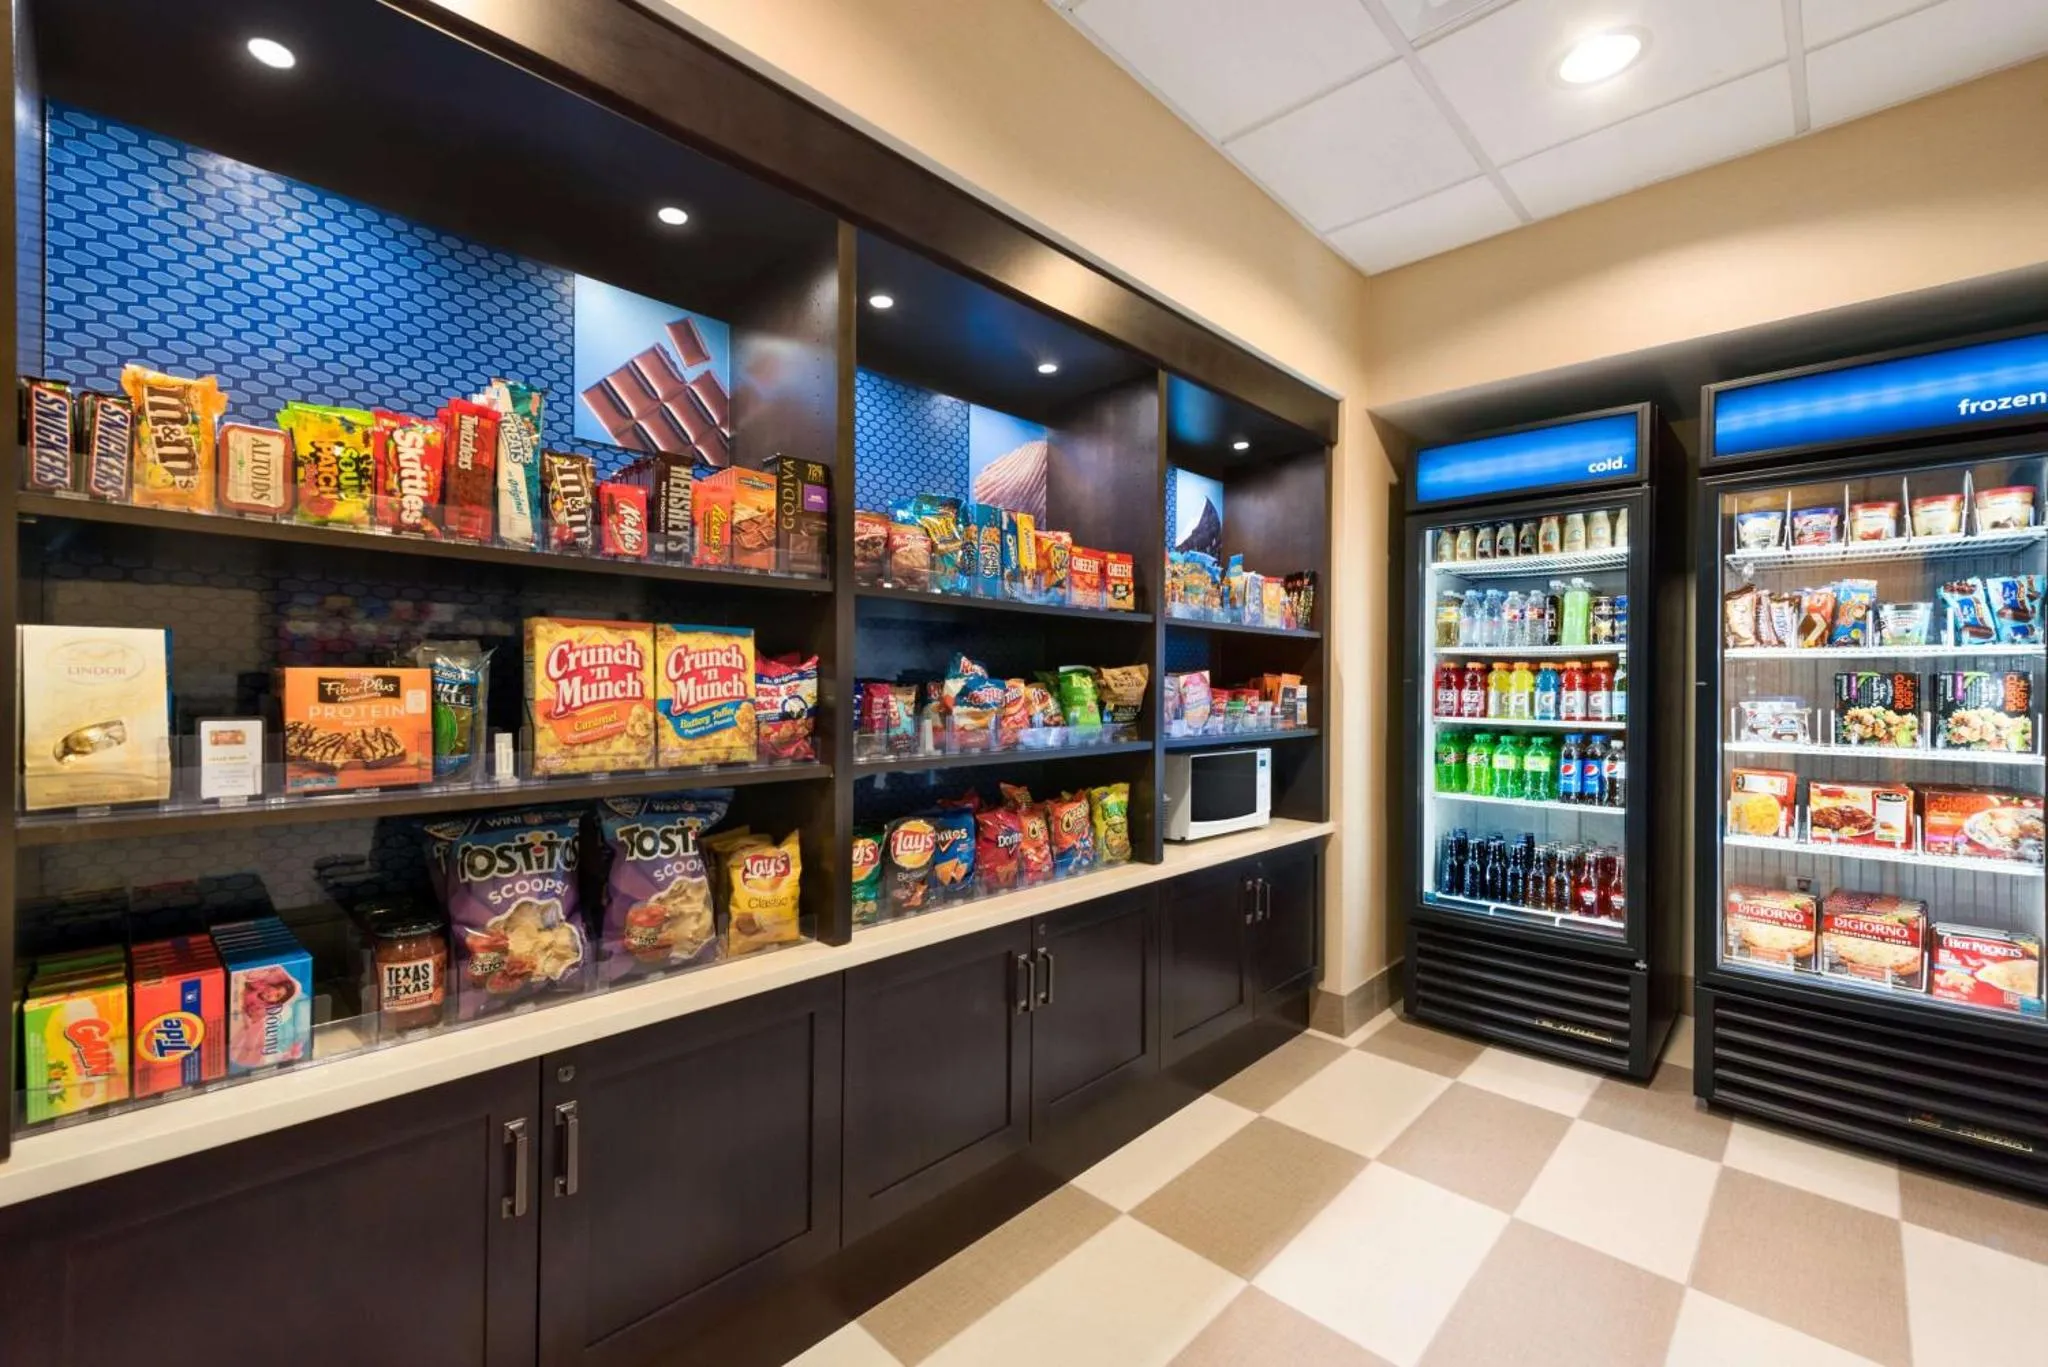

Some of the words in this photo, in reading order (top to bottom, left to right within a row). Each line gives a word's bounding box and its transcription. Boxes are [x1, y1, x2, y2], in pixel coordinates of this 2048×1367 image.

[34, 390, 70, 490] SNICKERS
[93, 403, 132, 499] SNICKERS
[458, 414, 479, 471] Twizzlers
[501, 412, 524, 464] TREATS
[250, 438, 272, 501] ALTOIDS
[314, 441, 340, 500] PATCH
[393, 429, 428, 523] Skittles
[1588, 456, 1628, 473] cold.
[667, 465, 691, 552] HERSHEY'S
[782, 459, 796, 530] GODIVA
[67, 666, 127, 677] LINDOR
[547, 642, 641, 681] Crunch
[667, 646, 744, 681] Crunch
[308, 704, 405, 720] PROTEIN
[554, 672, 642, 714] Munch
[674, 674, 746, 712] Munch
[574, 711, 617, 731] Caramel
[488, 877, 570, 904] SCOOPS!
[1737, 902, 1804, 922] DIGIORNO
[1833, 917, 1908, 938] DIGIORNO
[386, 963, 430, 985] TEXAS
[387, 981, 430, 998] TEXAS
[154, 1018, 193, 1058] Tide
